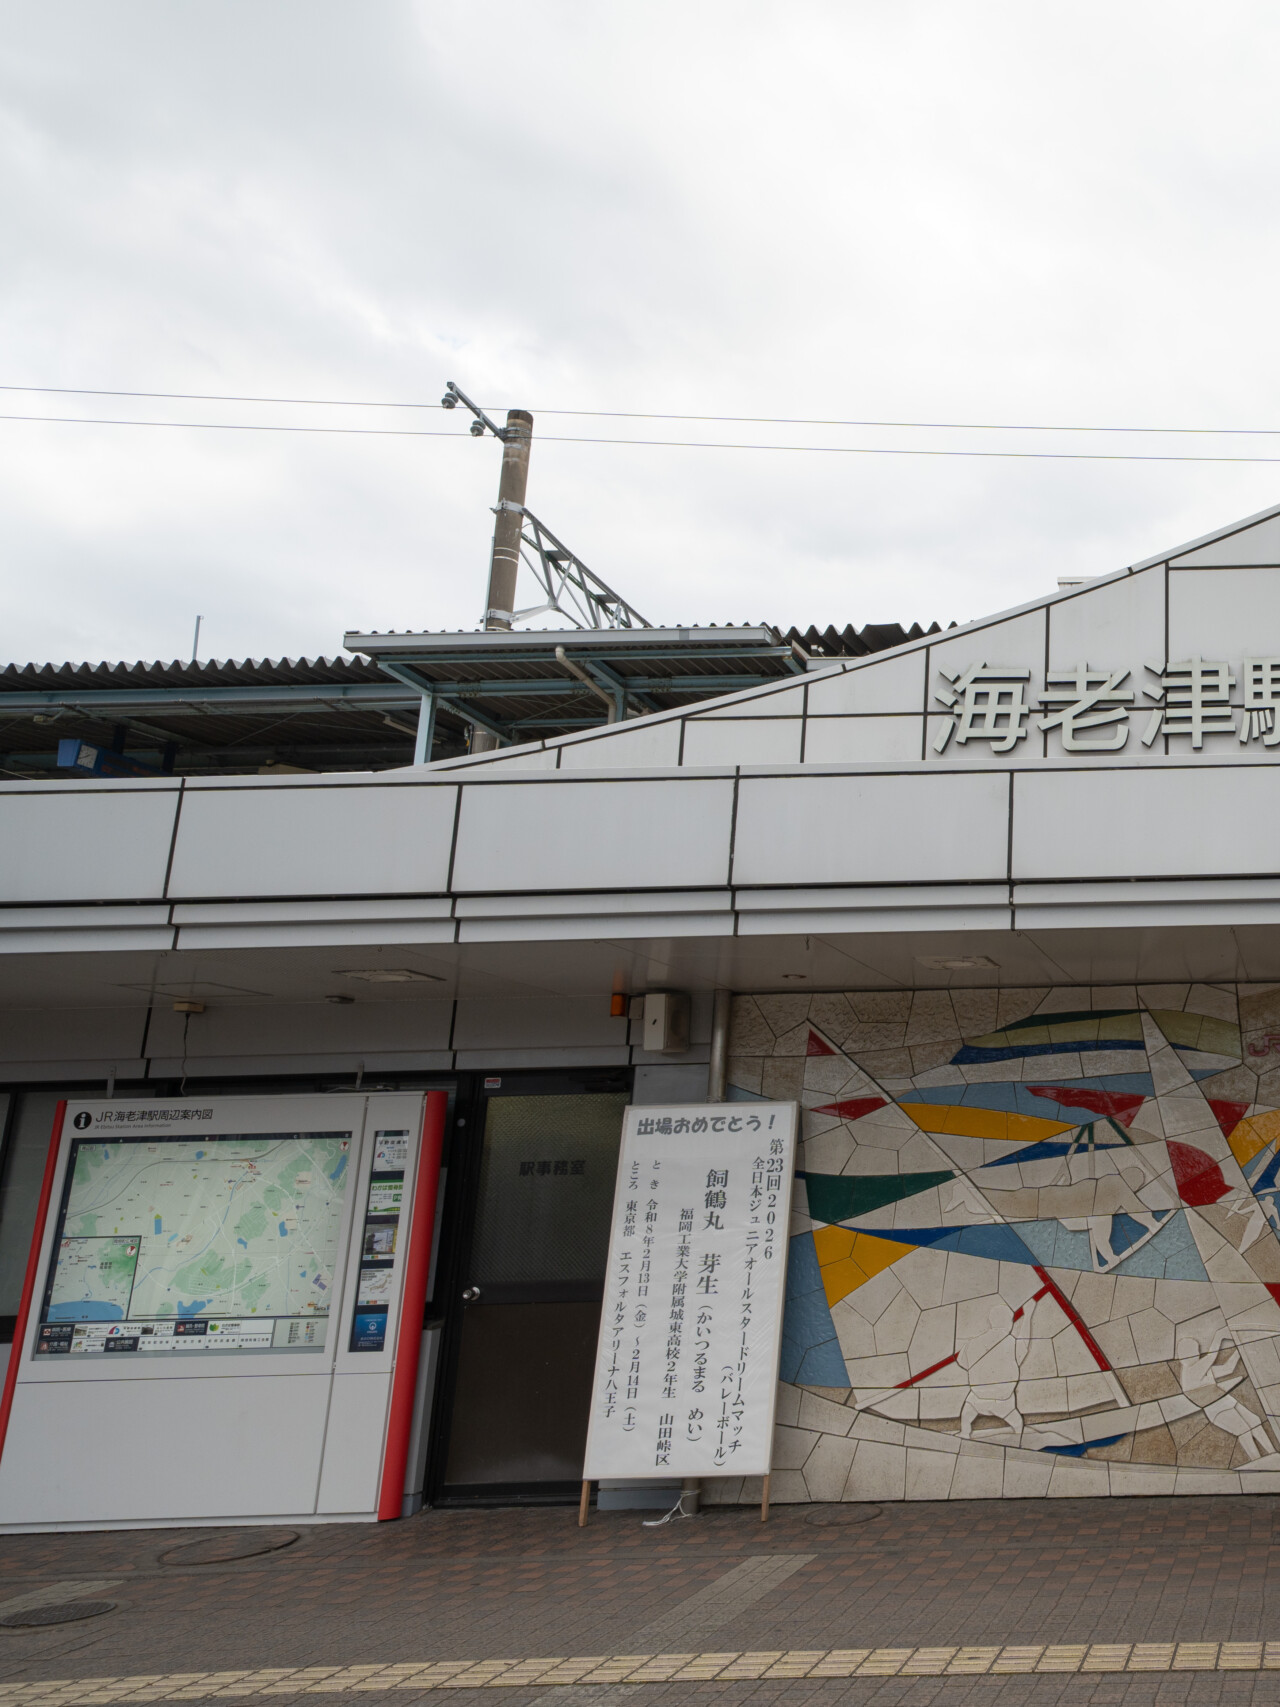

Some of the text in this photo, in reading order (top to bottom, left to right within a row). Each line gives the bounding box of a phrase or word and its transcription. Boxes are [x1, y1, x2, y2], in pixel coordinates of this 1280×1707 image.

[519, 1159, 587, 1177] 駅事務室
[628, 1160, 640, 1190] ところ
[623, 1200, 637, 1238] 東京都
[702, 1169, 729, 1231] 飼鶴丸
[656, 1413, 673, 1467] 山田峠区
